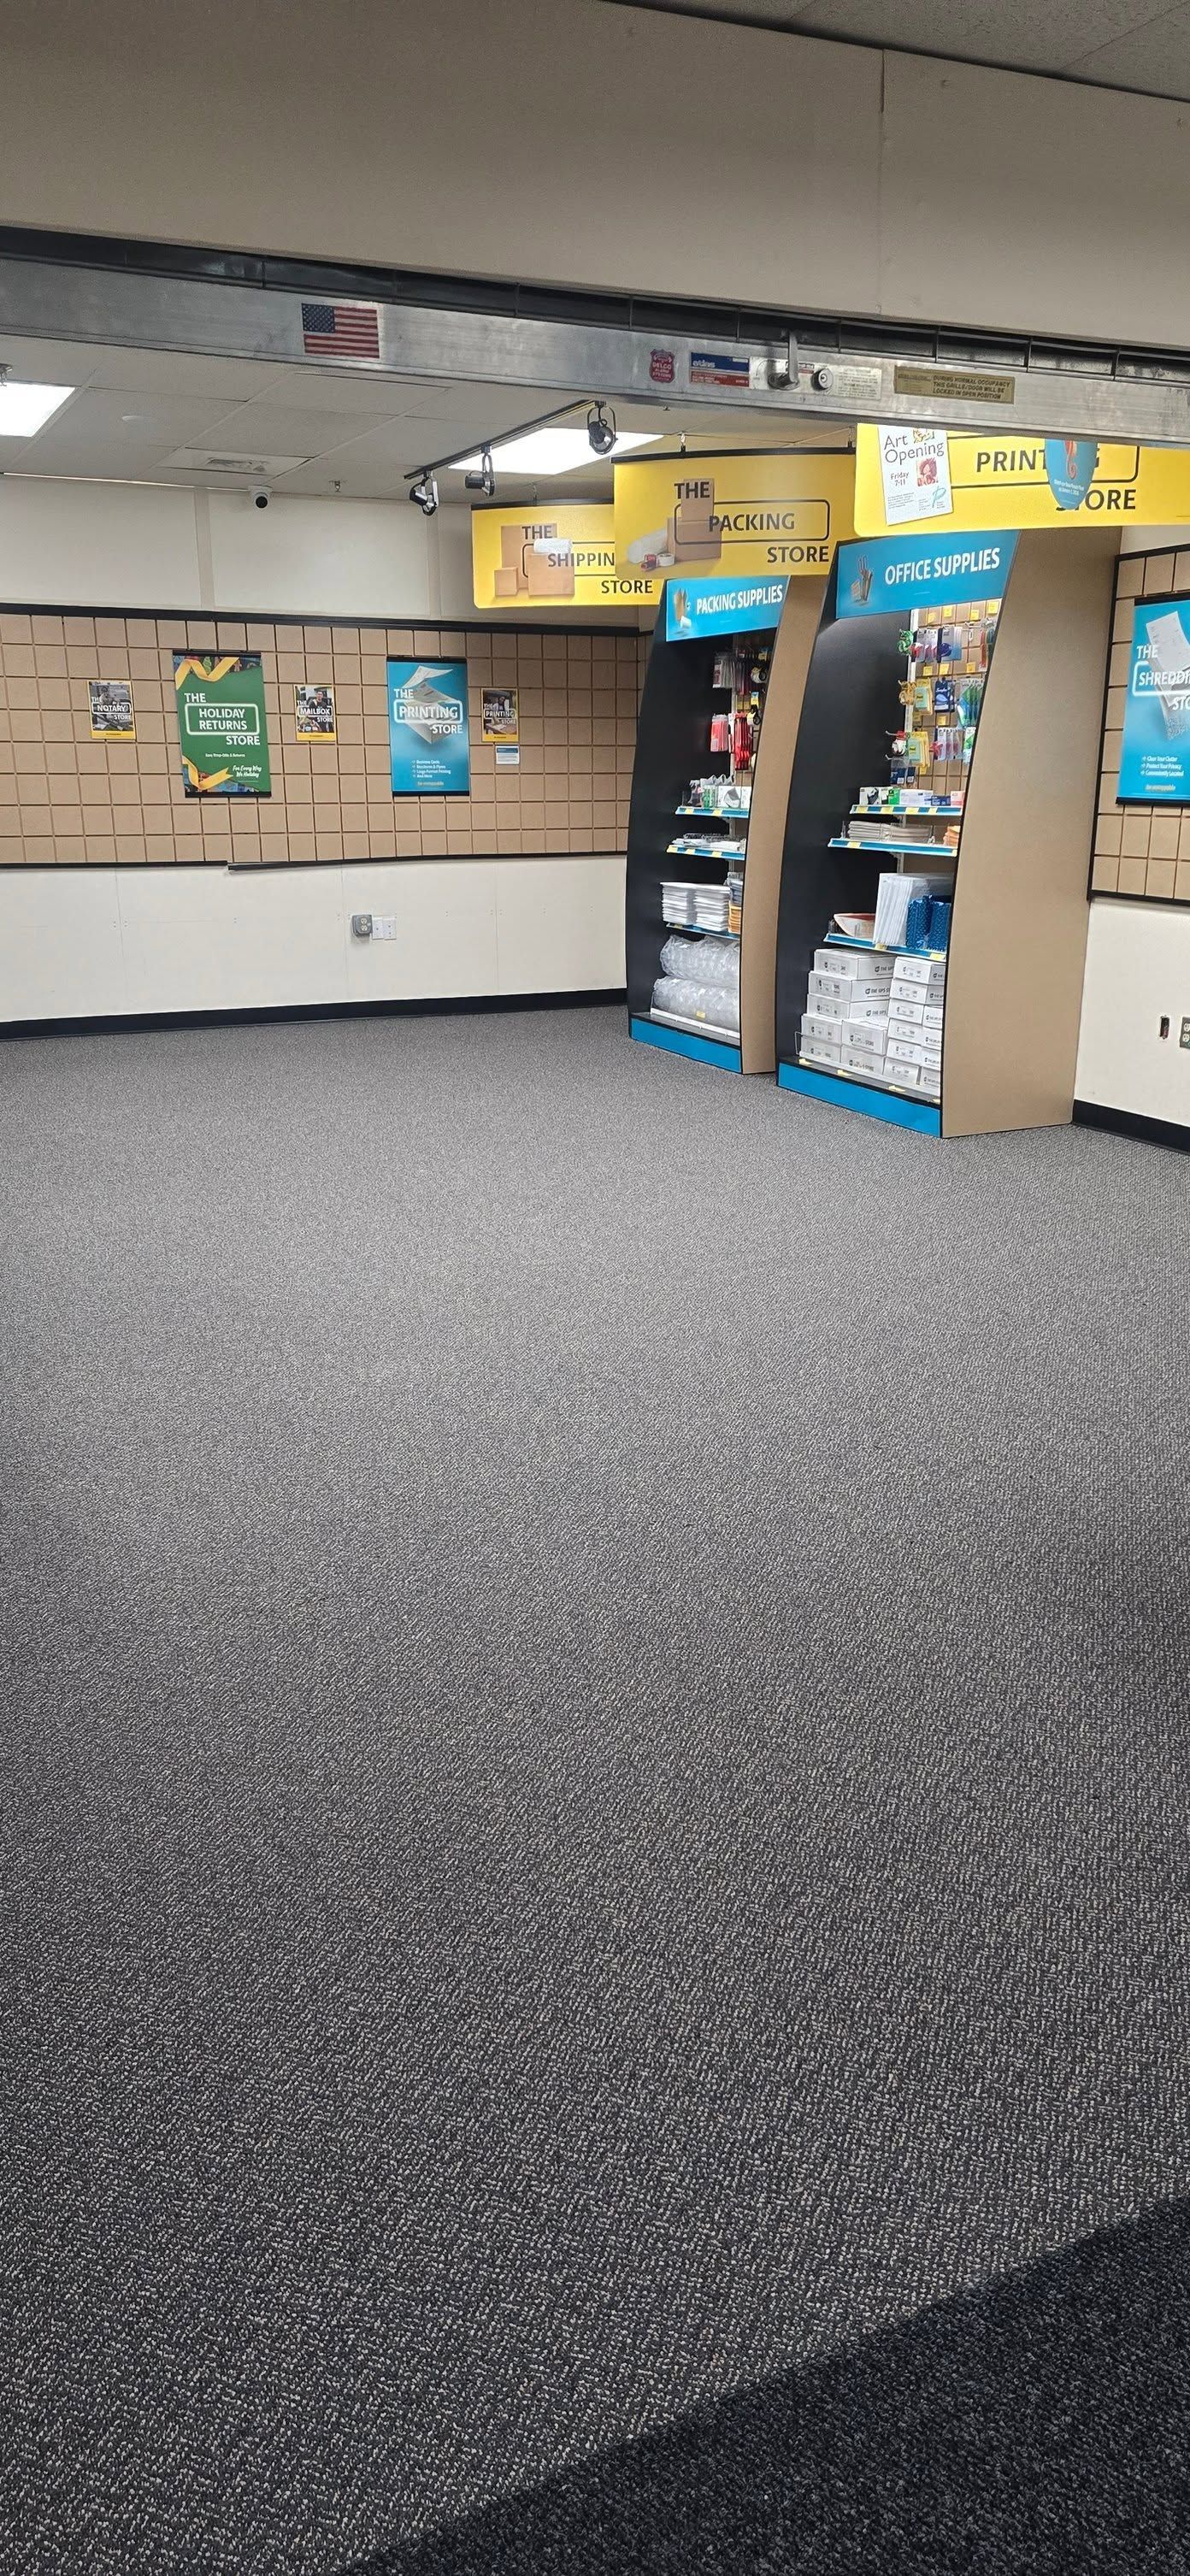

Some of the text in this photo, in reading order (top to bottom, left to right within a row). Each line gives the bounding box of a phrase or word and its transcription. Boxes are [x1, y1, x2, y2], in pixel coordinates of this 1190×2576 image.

[977, 379, 1011, 388] OCCUPANCY
[884, 435, 908, 451] Art
[885, 442, 945, 465] Opening
[976, 449, 1099, 473] PRINT
[890, 471, 910, 480] Friday
[674, 481, 710, 499] THE
[1056, 489, 1137, 511] ORE
[709, 513, 795, 533] PACKING
[521, 525, 553, 540] THE
[548, 552, 615, 568] SHIPPIN
[767, 545, 829, 563] STORE
[885, 547, 1000, 586] OFFICE SUPPLIES
[601, 580, 653, 594] STORE
[696, 584, 784, 615] PACKING SUPPLIES
[1136, 644, 1158, 659] THE
[184, 693, 207, 703] THE
[393, 688, 415, 699] THE
[198, 708, 245, 719] HOLIDAY
[398, 706, 458, 719] PRINTING
[198, 720, 248, 730] RETURNS
[432, 724, 464, 734] STORE
[226, 735, 261, 746] STORE
